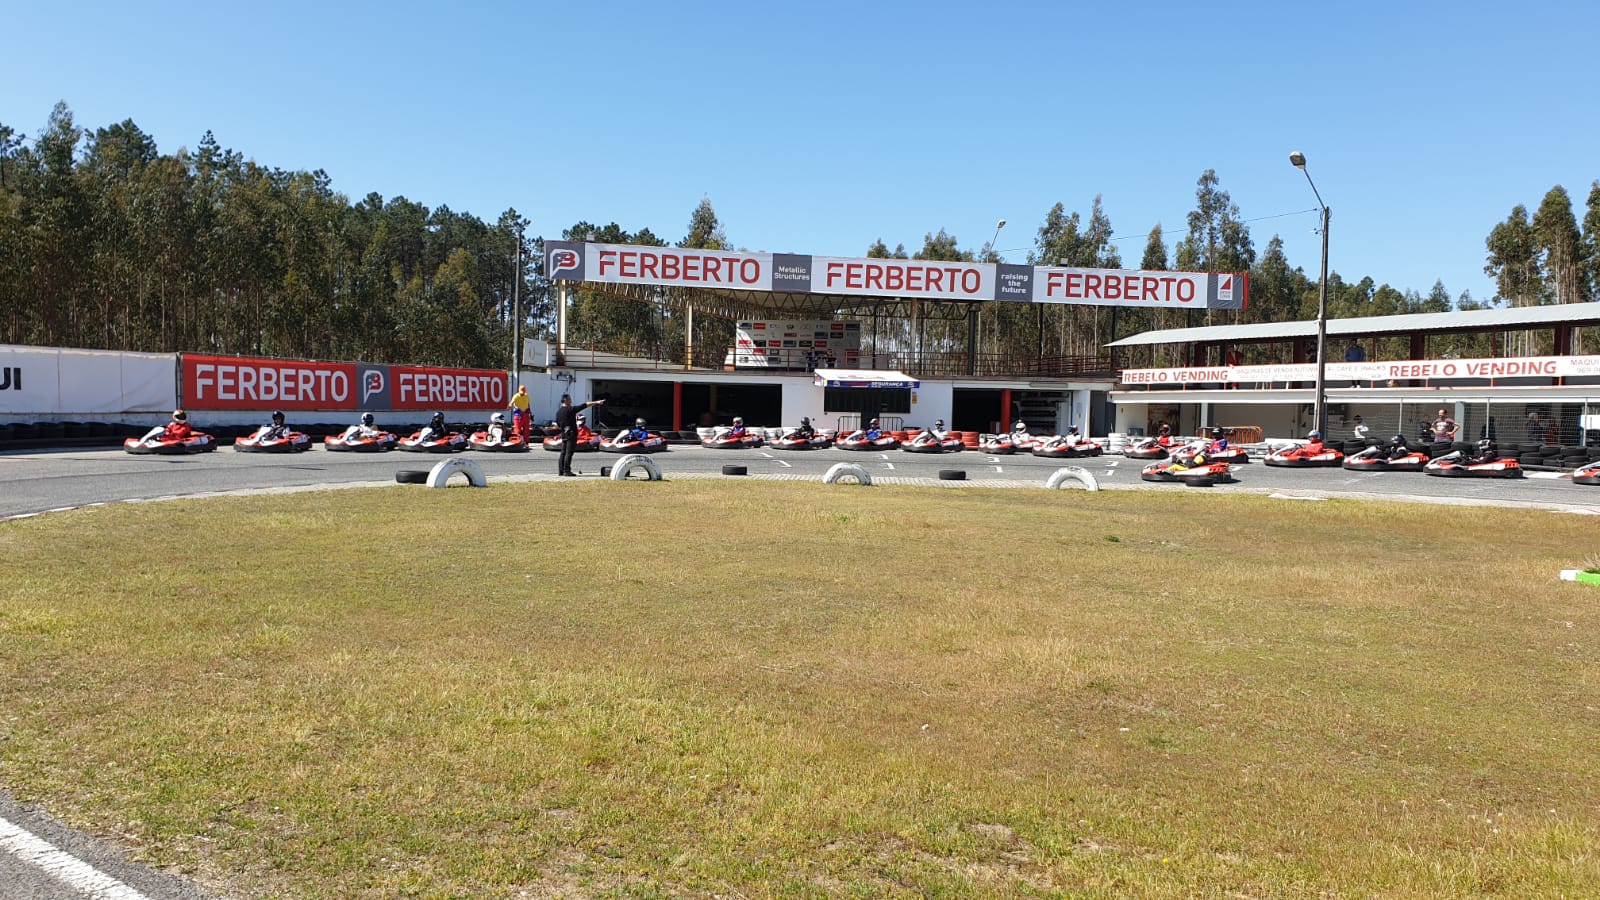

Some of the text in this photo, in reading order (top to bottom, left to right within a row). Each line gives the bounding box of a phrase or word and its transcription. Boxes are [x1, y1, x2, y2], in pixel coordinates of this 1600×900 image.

[600, 251, 761, 284] FERBERTO
[778, 265, 807, 274] Metallic
[774, 272, 810, 281] Structures
[827, 262, 981, 294] FERBERTO
[1000, 273, 1029, 282] raising
[1007, 280, 1021, 288] the
[1001, 286, 1027, 294] future
[1047, 273, 1195, 304] FERBERTO
[1124, 371, 1168, 384] REBELO
[1173, 369, 1229, 382] VENDING
[1389, 361, 1557, 378] REBELO VENDING
[196, 364, 348, 403] FERBERTO
[399, 373, 503, 403] FERBERTO
